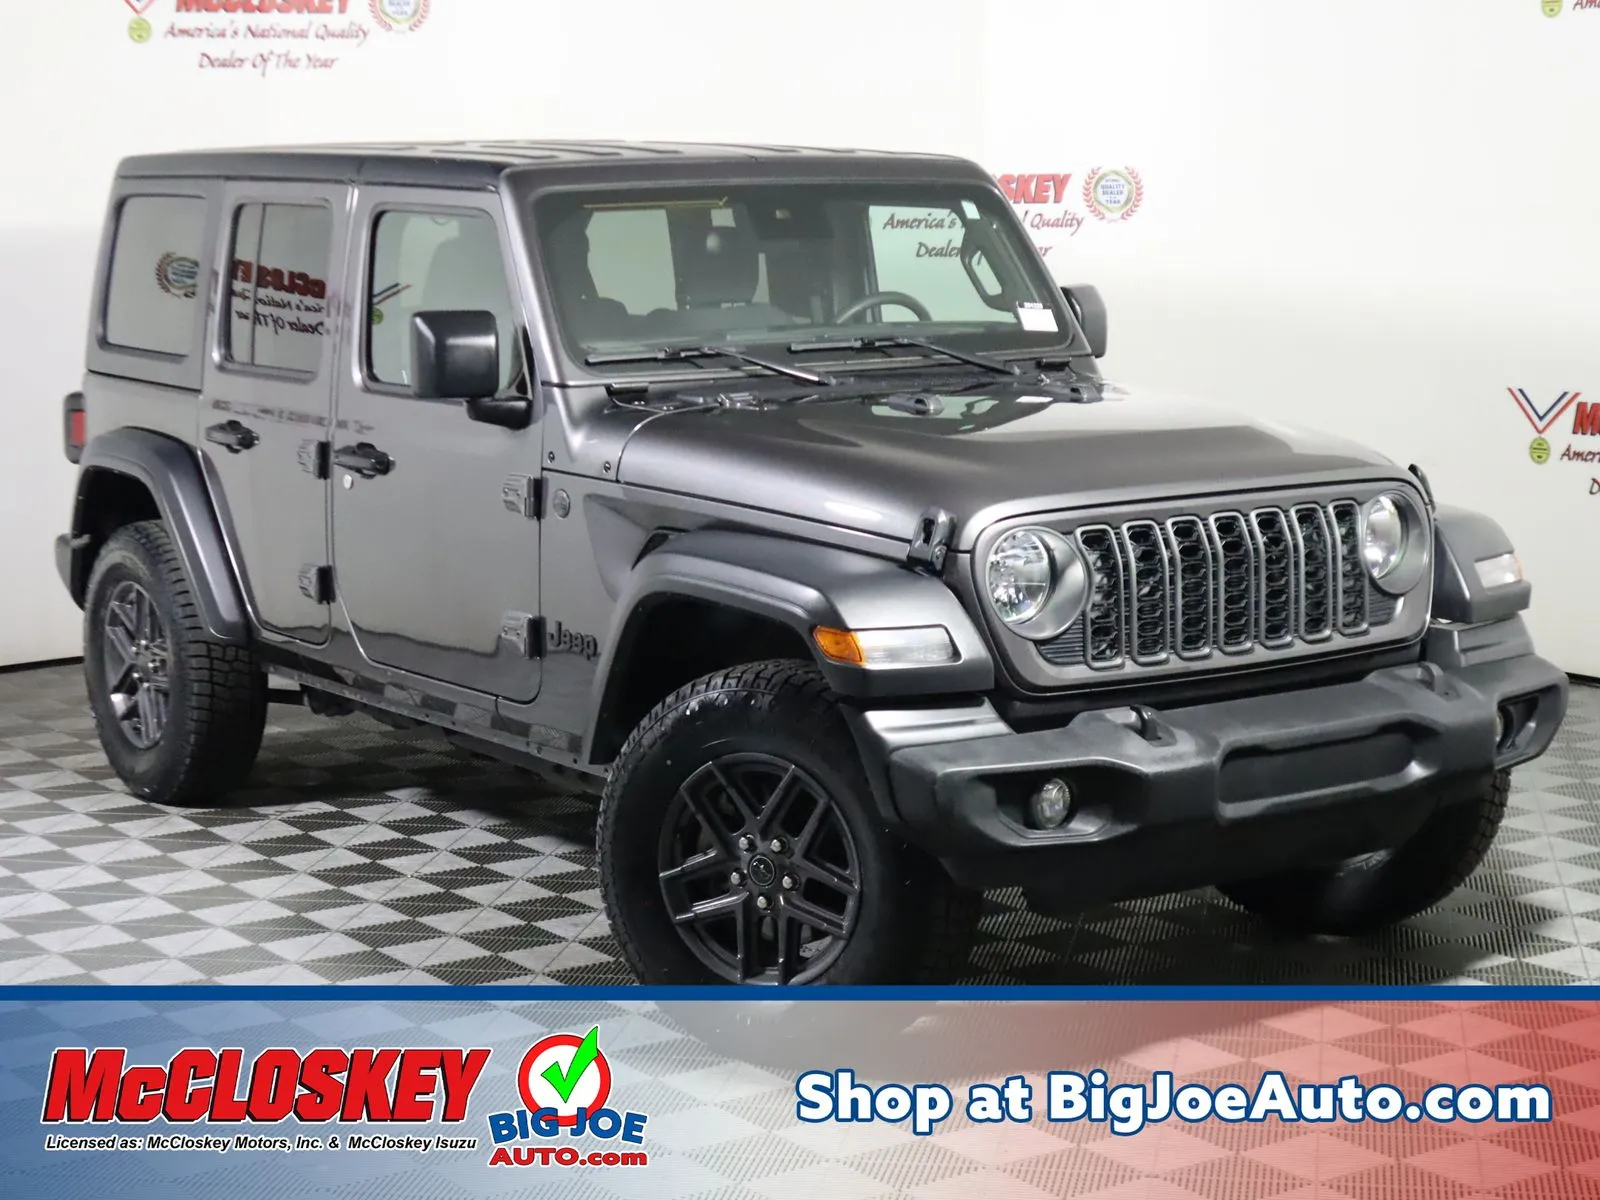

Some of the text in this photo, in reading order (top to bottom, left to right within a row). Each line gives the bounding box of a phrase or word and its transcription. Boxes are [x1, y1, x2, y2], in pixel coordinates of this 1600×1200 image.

[164, 20, 370, 47] America's National Quality
[198, 50, 339, 77] Dealer Of The Year
[882, 209, 957, 230] America's
[1030, 208, 1085, 237] Quality
[915, 240, 961, 259] Dealer
[547, 620, 598, 661] Jeep
